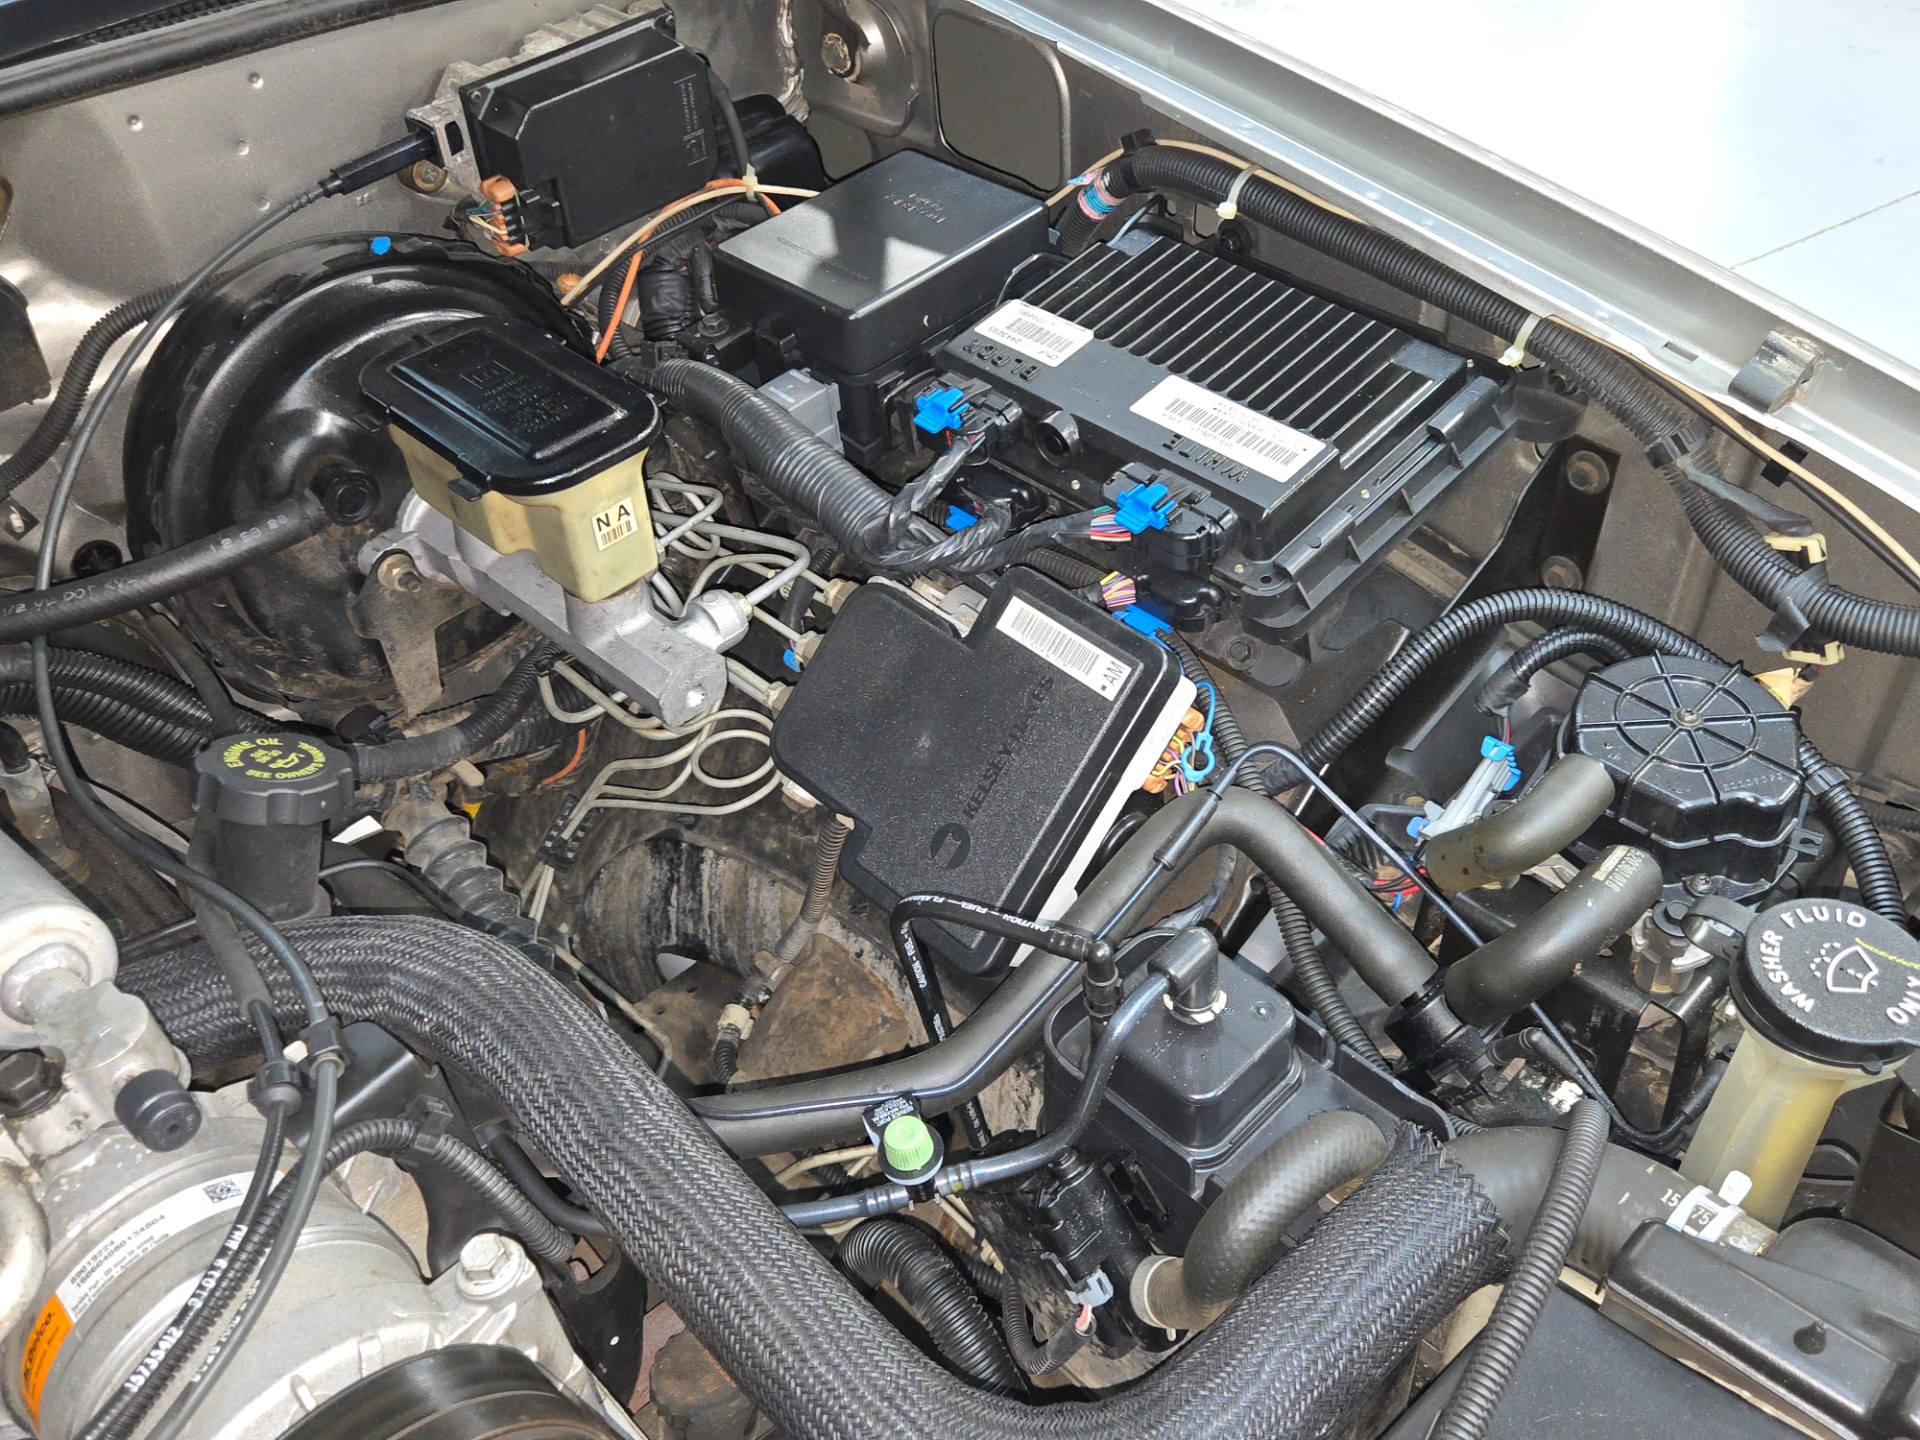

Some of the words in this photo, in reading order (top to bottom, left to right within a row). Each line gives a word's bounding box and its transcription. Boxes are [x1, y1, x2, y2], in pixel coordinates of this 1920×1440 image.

[963, 337, 1041, 381] BLACK
[1162, 433, 1249, 483] WHITE
[1105, 660, 1126, 687] AM
[223, 740, 257, 768] ENGINE
[255, 737, 284, 746] OIL
[297, 741, 327, 763] MANUAL
[245, 769, 273, 779] SEE
[274, 762, 324, 780] OWNER'S
[961, 901, 989, 914] FUEL
[1779, 905, 1867, 929] FLUID
[1002, 913, 1050, 933] CAUTION
[1759, 929, 1816, 1013] WASHER
[1886, 975, 1920, 1025] ONLY
[1659, 1187, 1682, 1207] 15
[1690, 1206, 1712, 1225] 75
